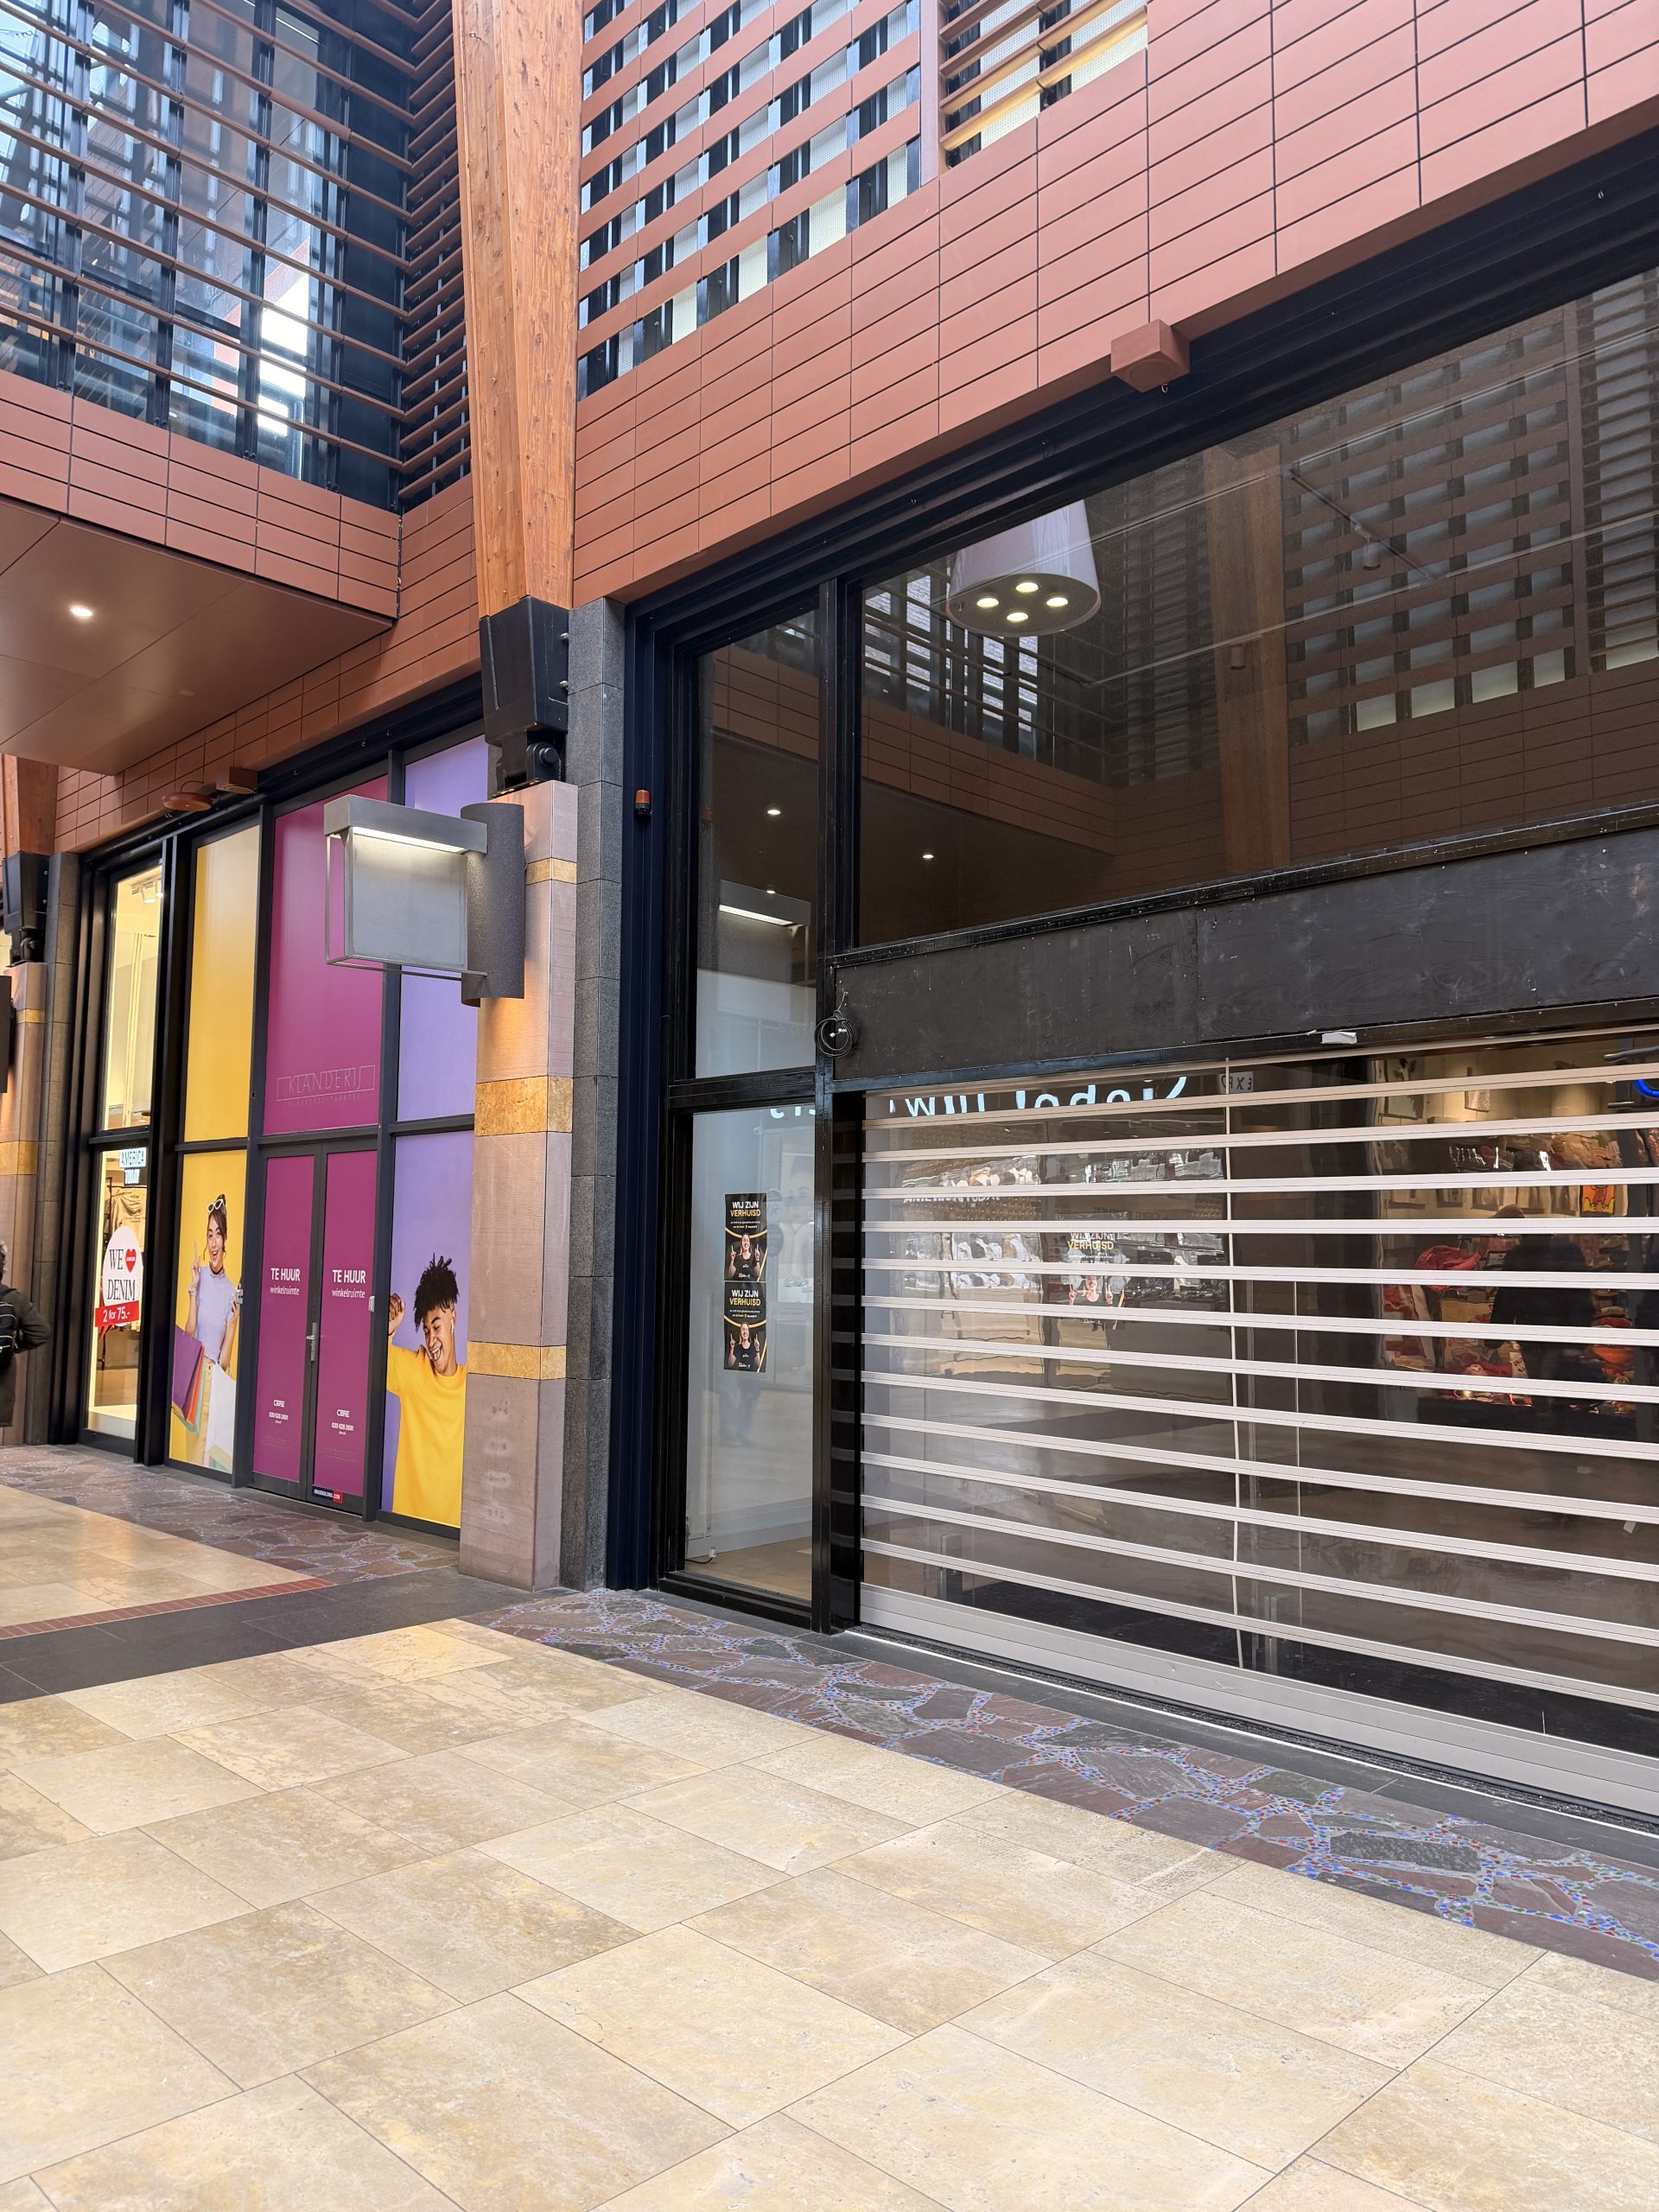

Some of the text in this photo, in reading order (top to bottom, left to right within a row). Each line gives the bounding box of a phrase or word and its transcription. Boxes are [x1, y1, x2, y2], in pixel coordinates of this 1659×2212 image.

[730, 1209, 761, 1217] VERHUISD
[109, 1249, 124, 1270] WE
[270, 1268, 301, 1281] TE HUUR
[333, 1269, 366, 1284] TE HUUR
[107, 1279, 136, 1301] DENIM
[270, 1285, 300, 1295] winkelruimte
[332, 1287, 365, 1299] winkelruimte
[731, 1289, 759, 1298] WIJ ZIJN
[729, 1298, 761, 1306] VERHUISD
[103, 1309, 108, 1323] 2
[108, 1309, 117, 1320] for
